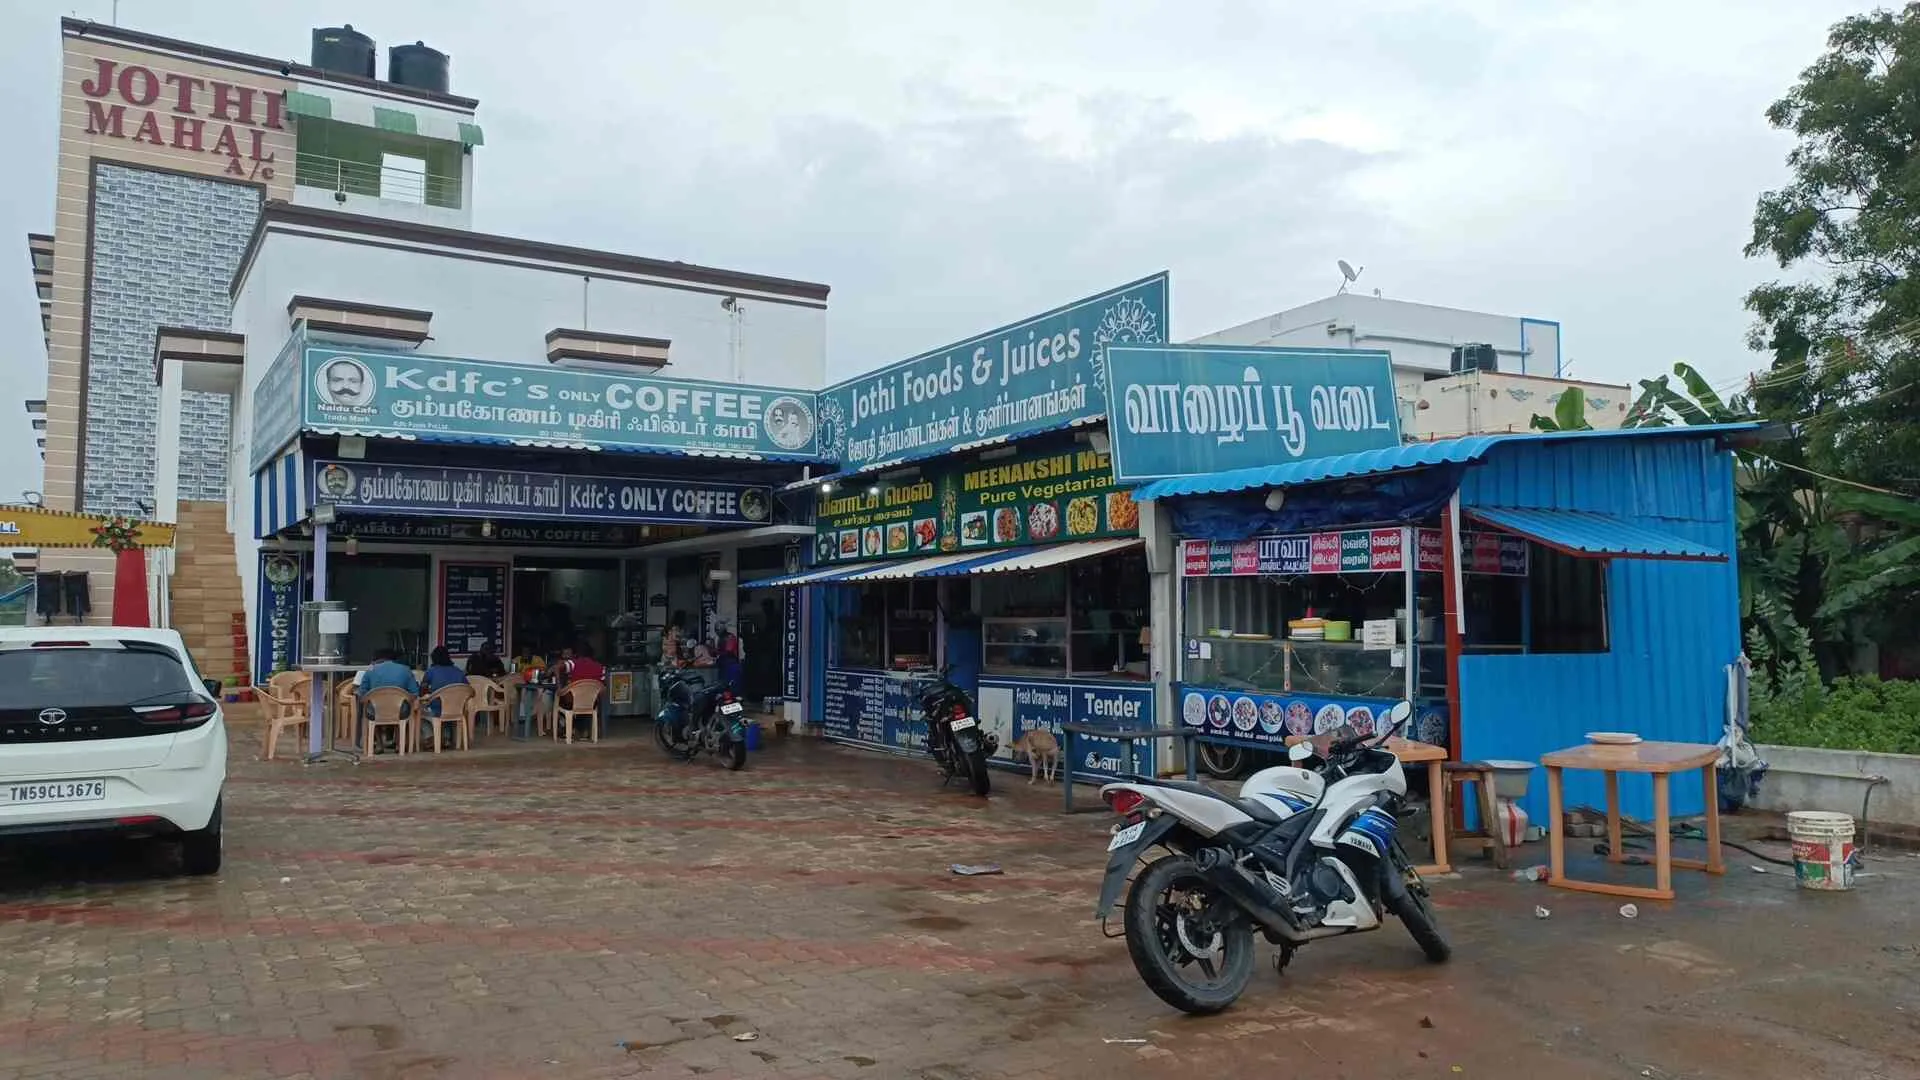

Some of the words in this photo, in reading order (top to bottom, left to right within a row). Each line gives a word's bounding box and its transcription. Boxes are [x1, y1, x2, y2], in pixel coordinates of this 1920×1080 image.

[81, 58, 286, 129] JOTHI
[85, 100, 274, 163] MAHAL
[384, 366, 549, 400] Kdfc's
[558, 390, 600, 402] ONLY
[606, 383, 763, 421] COFFEE
[851, 375, 896, 428] Jothi
[903, 356, 964, 407] Foods
[971, 347, 993, 385] &
[1000, 327, 1081, 386] Juices
[391, 395, 562, 425] கும்பகோணம்
[712, 421, 759, 441] காபி
[848, 428, 877, 462] ஜோதி
[878, 405, 960, 458] தின்பண்டங்கள்
[962, 406, 973, 435] &
[975, 372, 1087, 437] குளிர்பானங்கள்
[1272, 384, 1307, 457] பூ
[1310, 385, 1390, 432] வடை
[964, 454, 1072, 491] MEENAKSHI
[570, 484, 616, 510] Kdfc's
[620, 486, 668, 512] ONLY
[672, 489, 737, 515] COFFEE
[979, 491, 1017, 505] Pure
[501, 528, 539, 539] ONLY
[545, 529, 601, 541] COFFEE
[1259, 539, 1309, 559] பாவா
[787, 620, 797, 695] COFFEE
[1084, 693, 1142, 718] Tender
[10, 782, 103, 801] TN59CL3676
